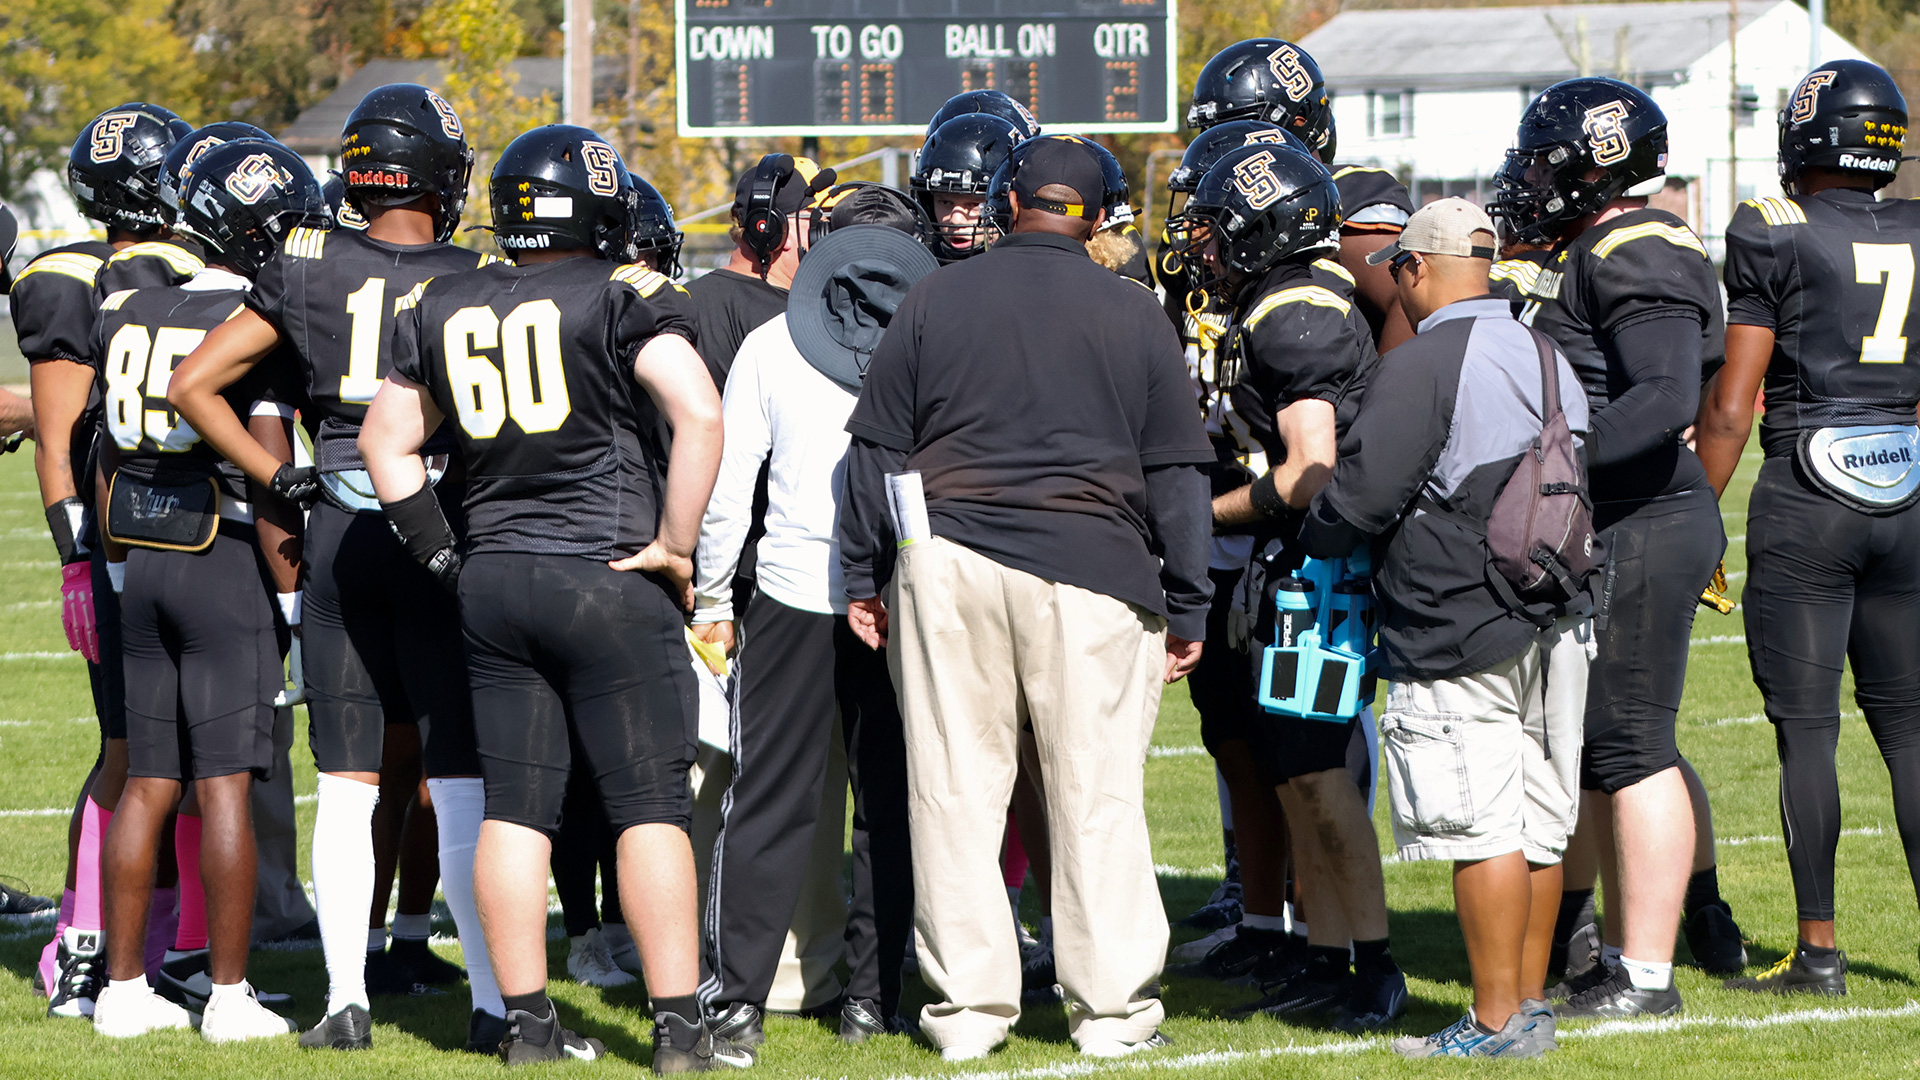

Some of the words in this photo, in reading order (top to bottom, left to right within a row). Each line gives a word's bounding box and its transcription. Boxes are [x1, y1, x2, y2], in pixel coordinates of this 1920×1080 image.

[689, 25, 774, 60] DOWN
[811, 25, 852, 59] TO
[859, 24, 904, 59] GO
[945, 23, 1014, 58] BALL
[1017, 23, 1056, 57] ON
[1094, 23, 1149, 57] QTR
[841, 63, 895, 123] 10
[1105, 61, 1138, 120] 2
[348, 170, 408, 188] Riddell
[1839, 153, 1897, 172] Riddell
[496, 234, 550, 249] Riddell
[1851, 242, 1915, 364] 7
[443, 298, 572, 440] 60
[105, 323, 207, 452] 85
[1843, 447, 1913, 469] Riddell
